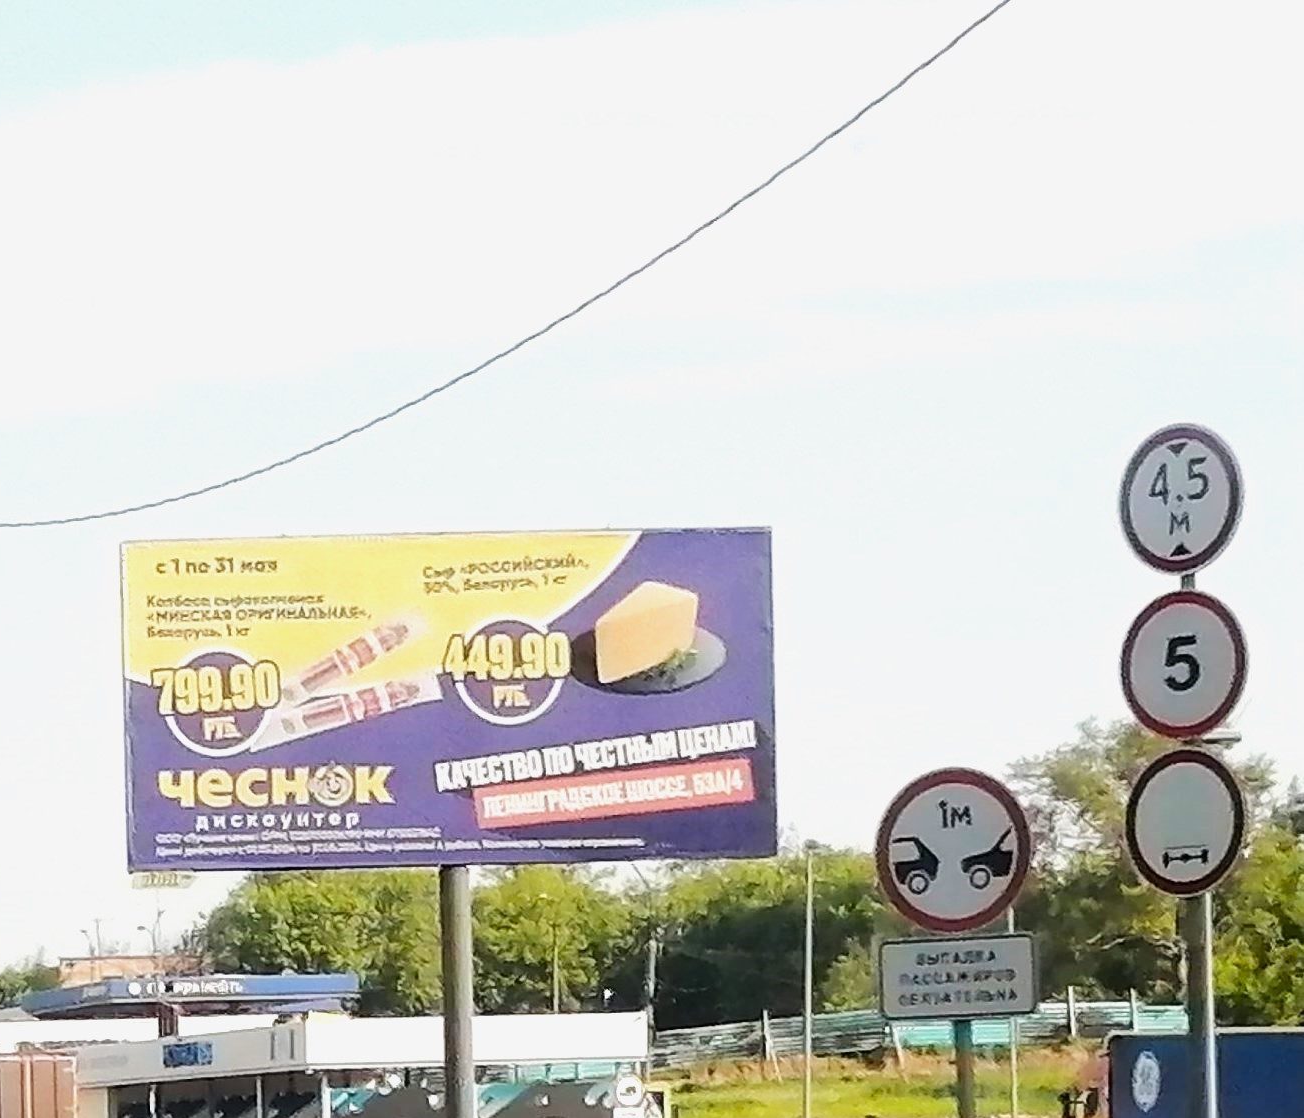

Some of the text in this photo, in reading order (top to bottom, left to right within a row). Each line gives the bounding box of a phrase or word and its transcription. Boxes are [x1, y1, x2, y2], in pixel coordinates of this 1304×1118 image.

[187, 560, 211, 574] по
[214, 557, 234, 574] 31
[443, 631, 572, 683] 449.90
[1164, 634, 1201, 692] 5
[151, 660, 281, 716] 799.90
[436, 749, 544, 792] КАЧЕСТВО
[543, 744, 576, 776] ПО
[574, 730, 679, 773] ЧЕСТНЫМ
[482, 780, 626, 819] ЛЕНИНГРАДСКОЕ
